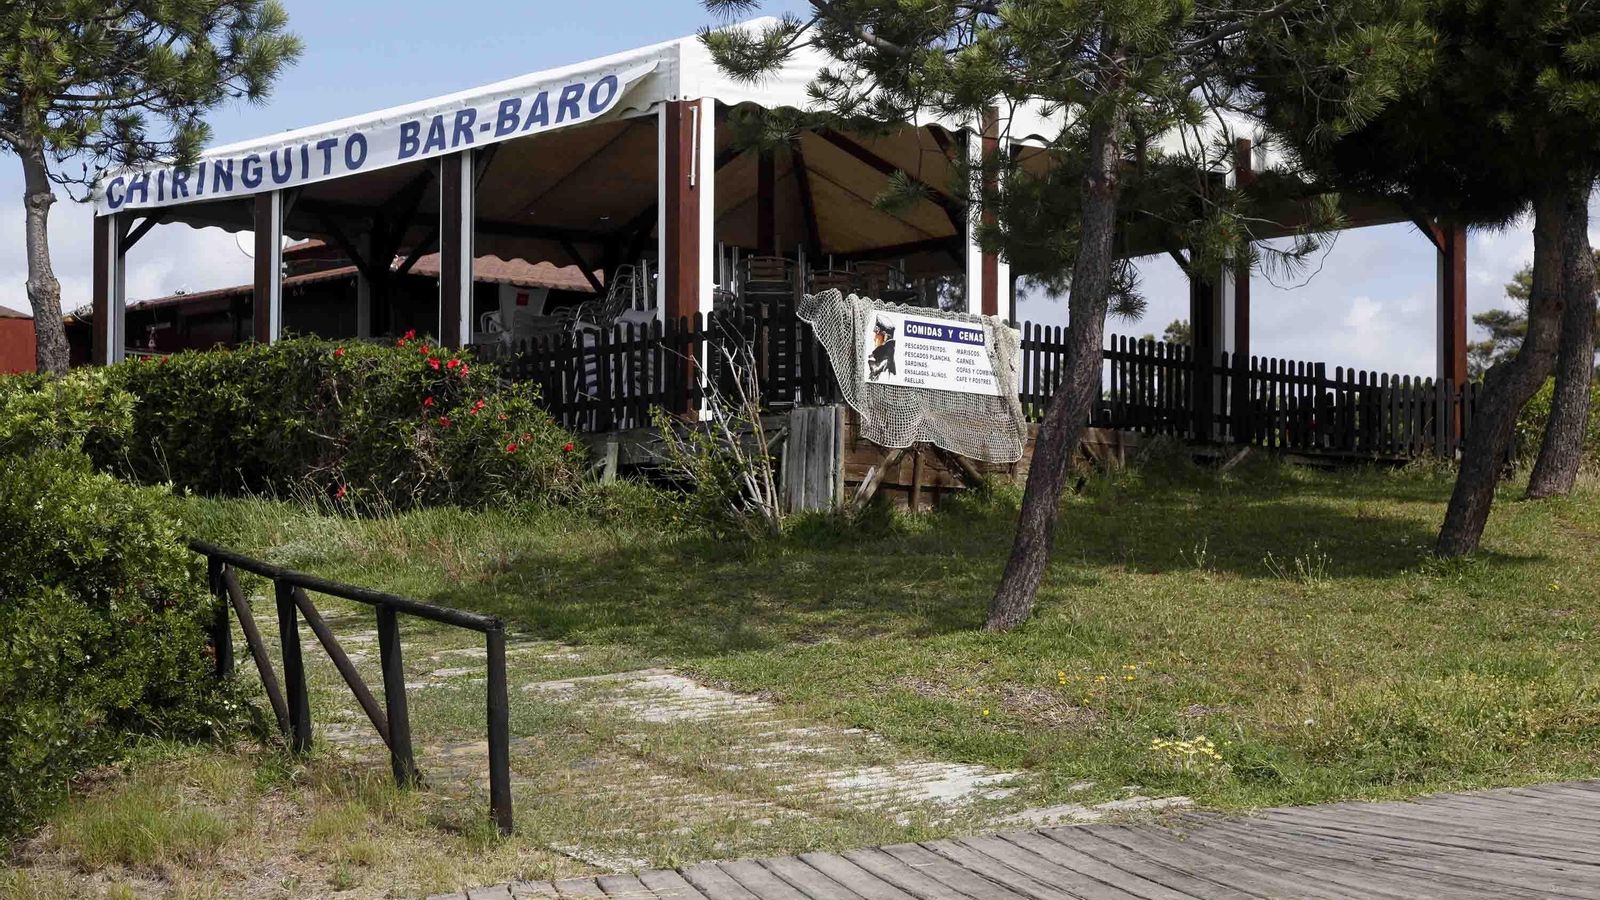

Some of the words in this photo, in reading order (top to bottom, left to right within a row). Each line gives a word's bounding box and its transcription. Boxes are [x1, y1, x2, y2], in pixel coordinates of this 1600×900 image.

[106, 132, 368, 209] CHIRINGUITO
[397, 74, 618, 160] BAR-BARO
[906, 324, 942, 338] COMIDAS
[948, 329, 954, 339] Y
[959, 331, 984, 343] CENAS
[904, 342, 929, 351] PESCADOS
[904, 351, 929, 360] PESCADOS
